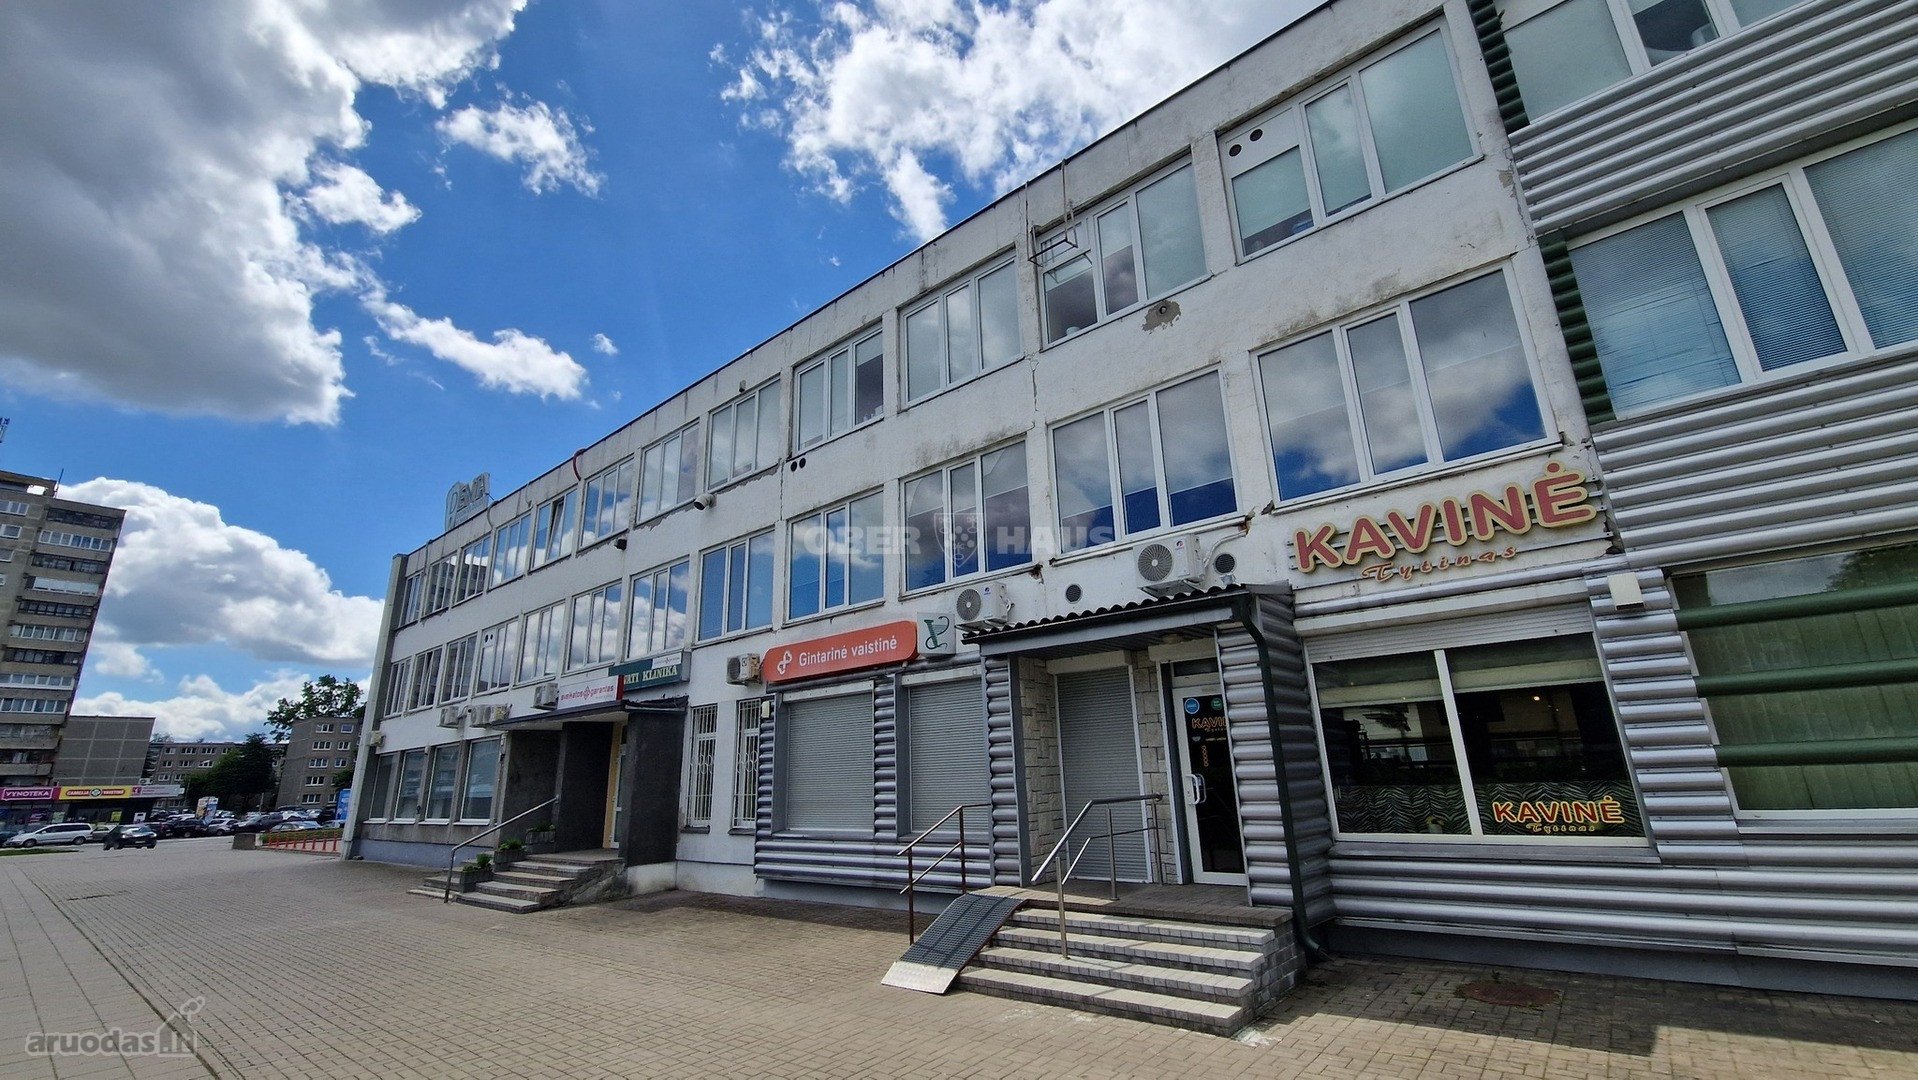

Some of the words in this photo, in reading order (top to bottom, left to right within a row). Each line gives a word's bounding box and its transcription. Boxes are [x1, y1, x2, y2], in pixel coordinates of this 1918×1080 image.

[1293, 461, 1597, 573] KAVINĖ
[1361, 546, 1518, 583] Tytinas
[799, 645, 848, 667] Gintarinė
[851, 635, 898, 657] vaistinė
[624, 673, 639, 685] ATI
[642, 665, 677, 681] KLINIKA
[1492, 795, 1625, 823] KAVINĖ
